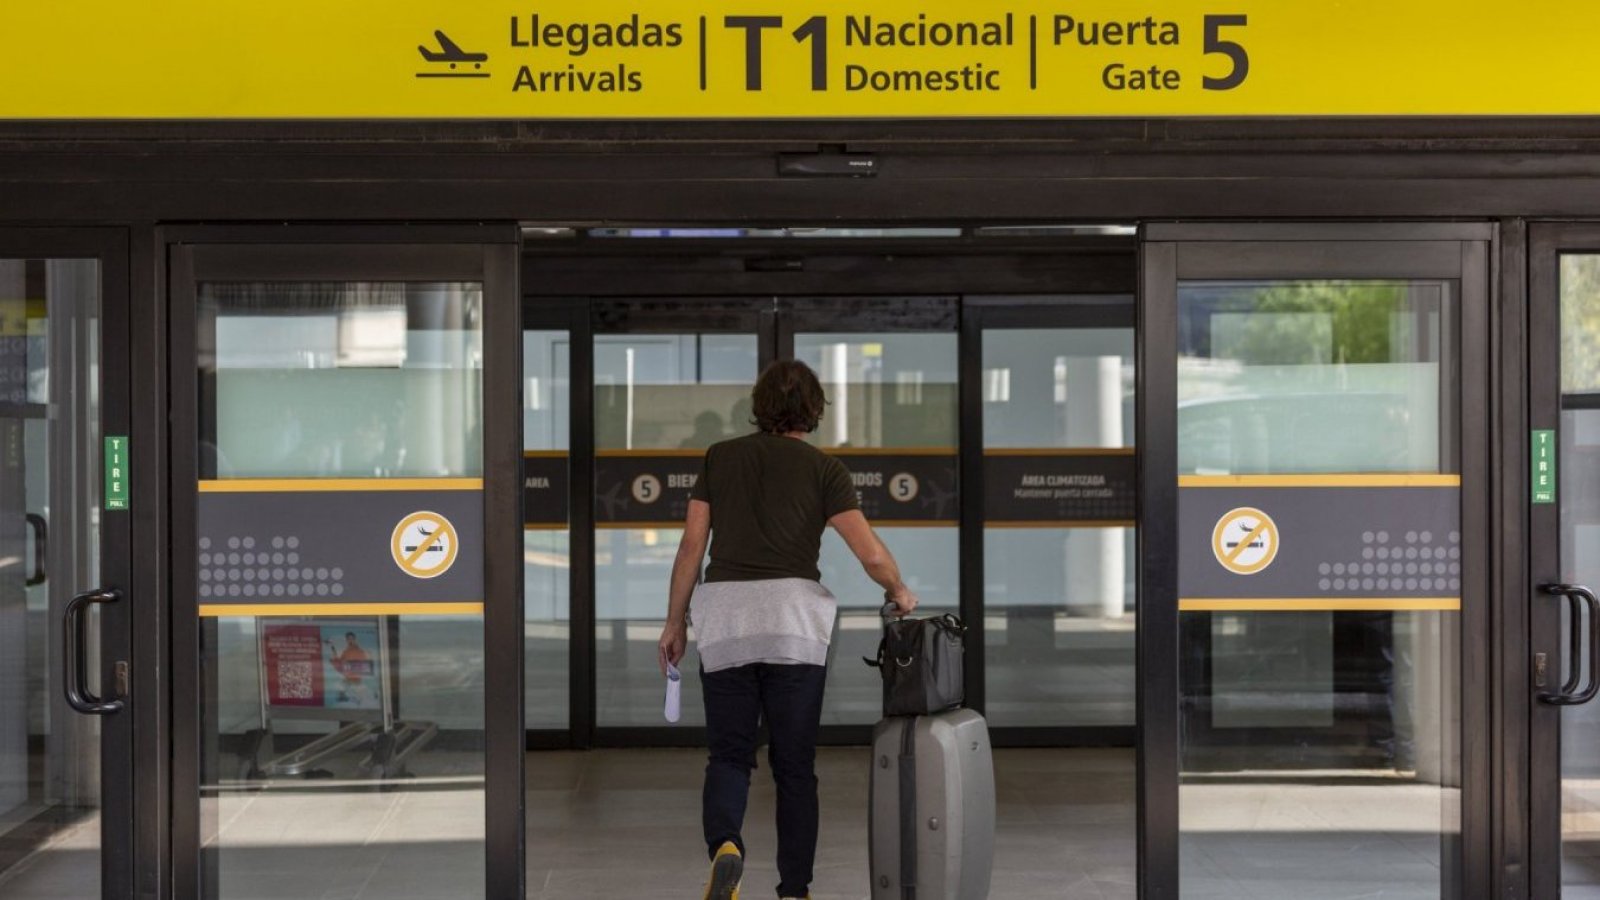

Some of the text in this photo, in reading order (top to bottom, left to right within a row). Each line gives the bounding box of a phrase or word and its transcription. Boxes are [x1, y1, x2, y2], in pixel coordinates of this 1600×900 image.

[511, 14, 682, 55] Llegadas
[846, 13, 1014, 46] Nacional
[1054, 16, 1180, 46] Puerta
[724, 16, 827, 91] T1
[1203, 14, 1249, 91] 5
[512, 64, 643, 92] Arrivals
[846, 63, 1000, 91] Domestic
[1102, 64, 1181, 91] Gate
[112, 439, 121, 492] TIRE
[1539, 433, 1547, 485] TIRE
[1046, 474, 1106, 486] CLIMATIZADA
